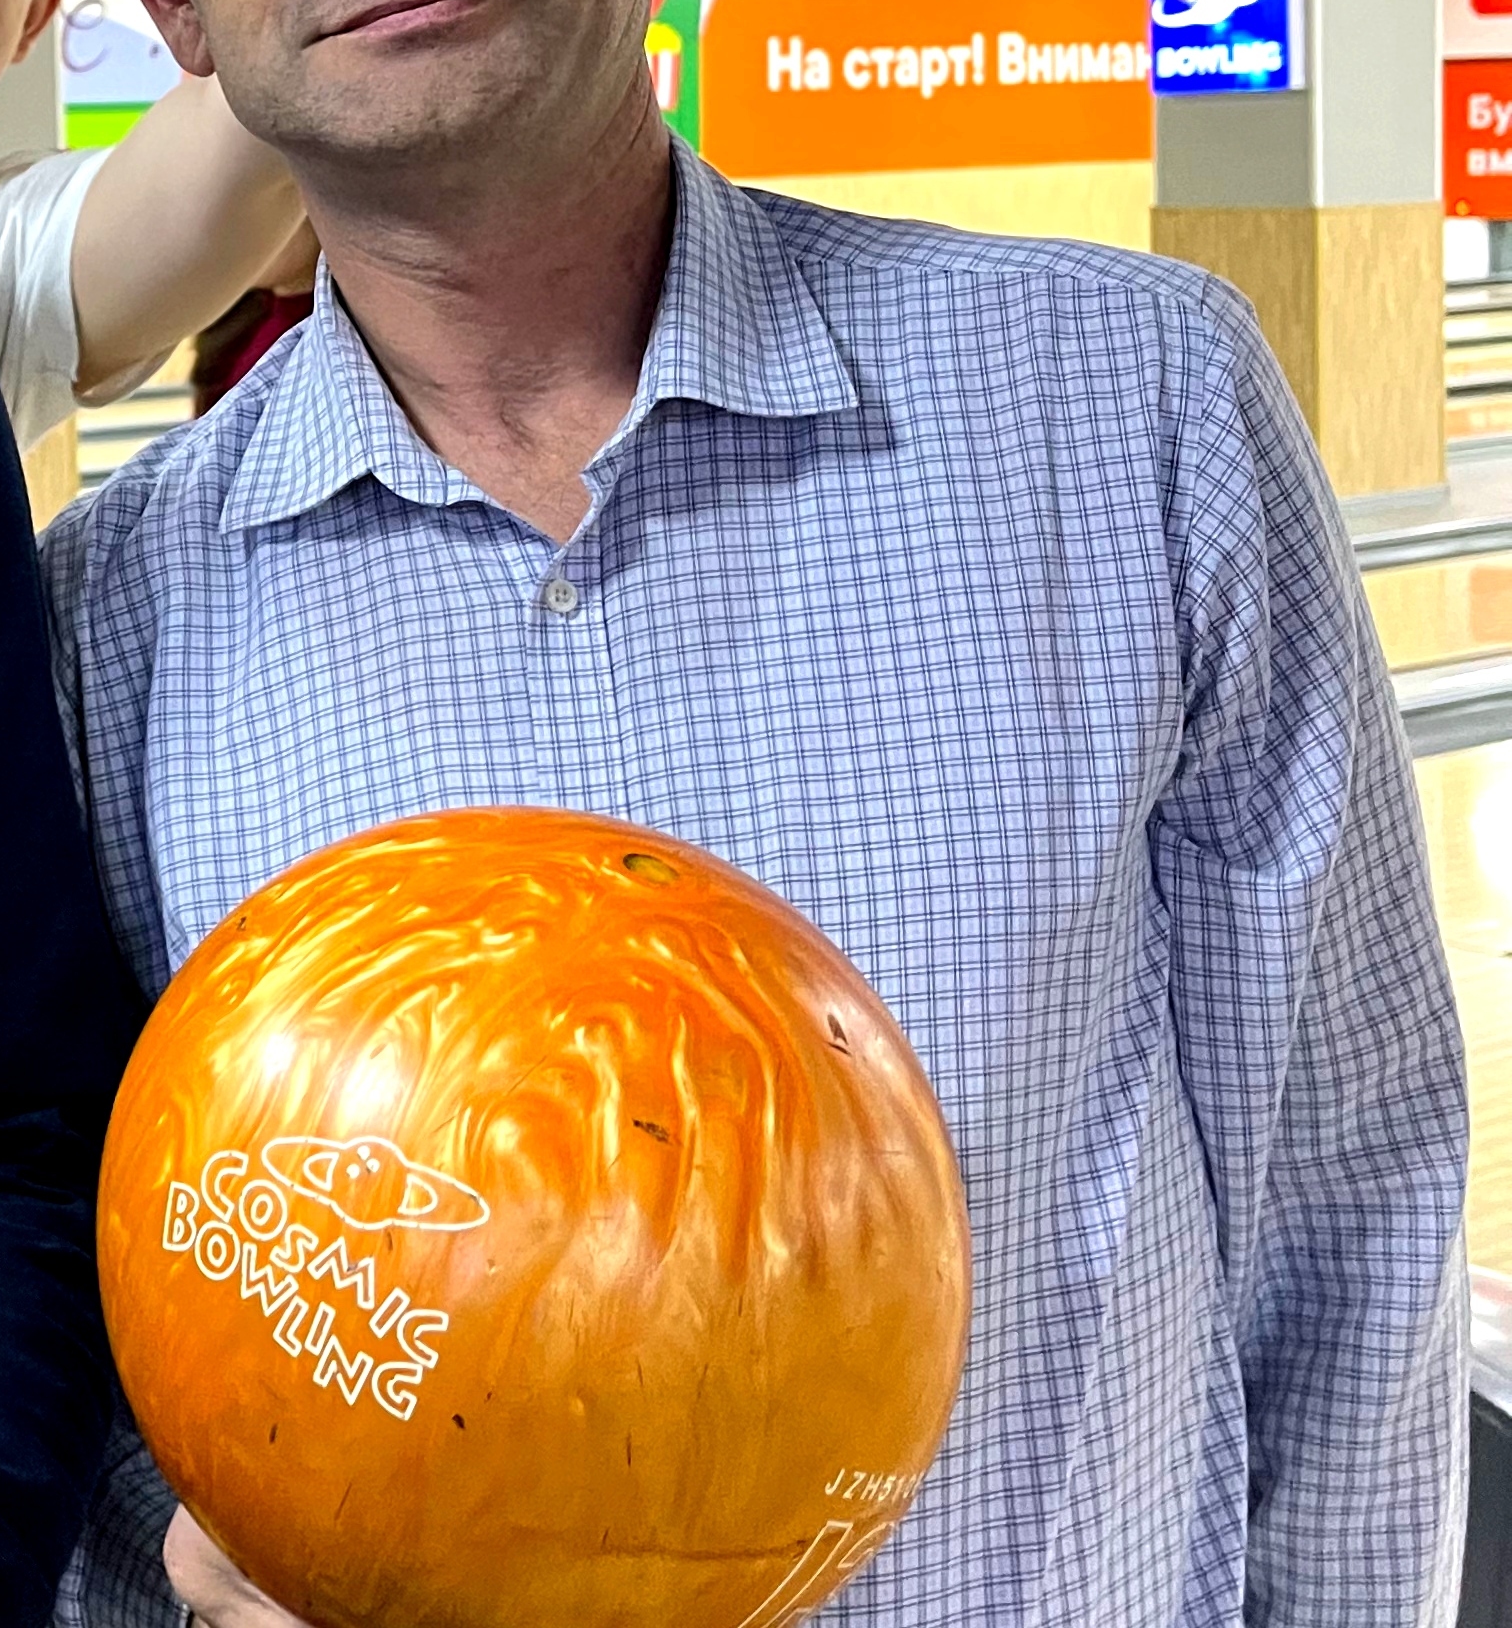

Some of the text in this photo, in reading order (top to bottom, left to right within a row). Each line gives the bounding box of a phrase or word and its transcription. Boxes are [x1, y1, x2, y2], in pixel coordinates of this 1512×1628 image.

[766, 35, 832, 93] На
[842, 33, 986, 99] старт!
[1156, 41, 1281, 79] BOWLING
[162, 1181, 423, 1421] BOWLING
[201, 1150, 449, 1368] COSMIC
